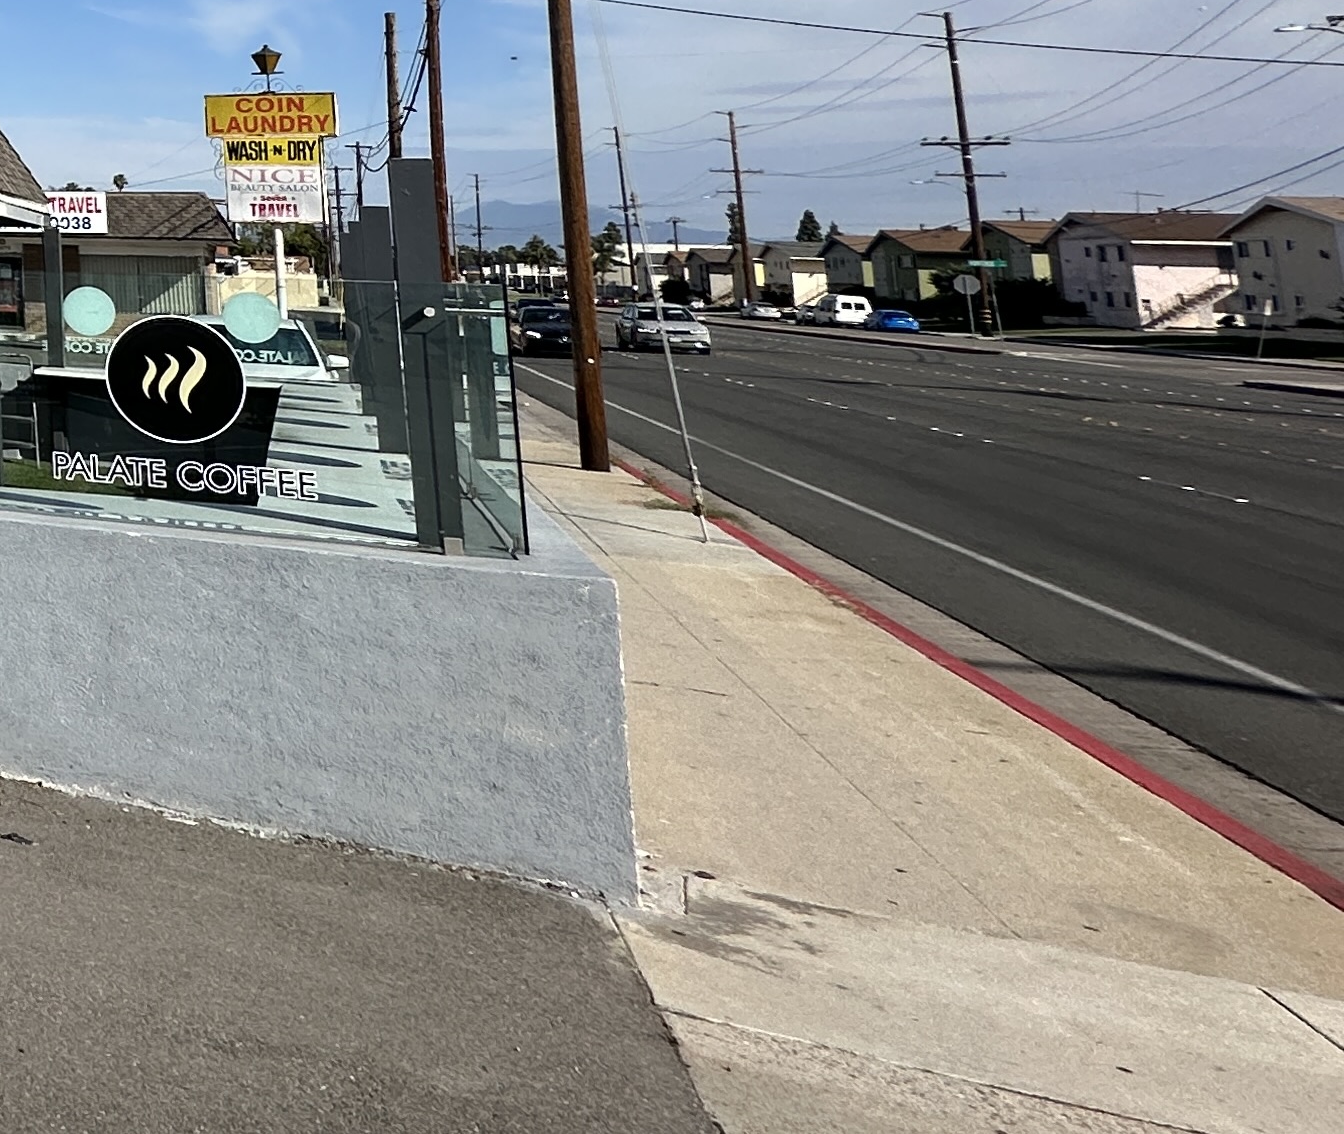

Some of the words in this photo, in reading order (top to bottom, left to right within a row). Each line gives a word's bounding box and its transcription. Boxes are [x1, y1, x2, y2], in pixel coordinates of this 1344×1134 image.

[235, 97, 305, 113] COIN
[211, 114, 330, 134] LAUNDRY
[231, 169, 318, 184] NICE
[231, 183, 274, 192] BEAUTY
[278, 183, 319, 192] SALON
[48, 196, 102, 214] TRAVEL
[249, 203, 300, 218] TRAVEL
[52, 450, 168, 489] PALATE
[176, 460, 319, 502] COFFEE
